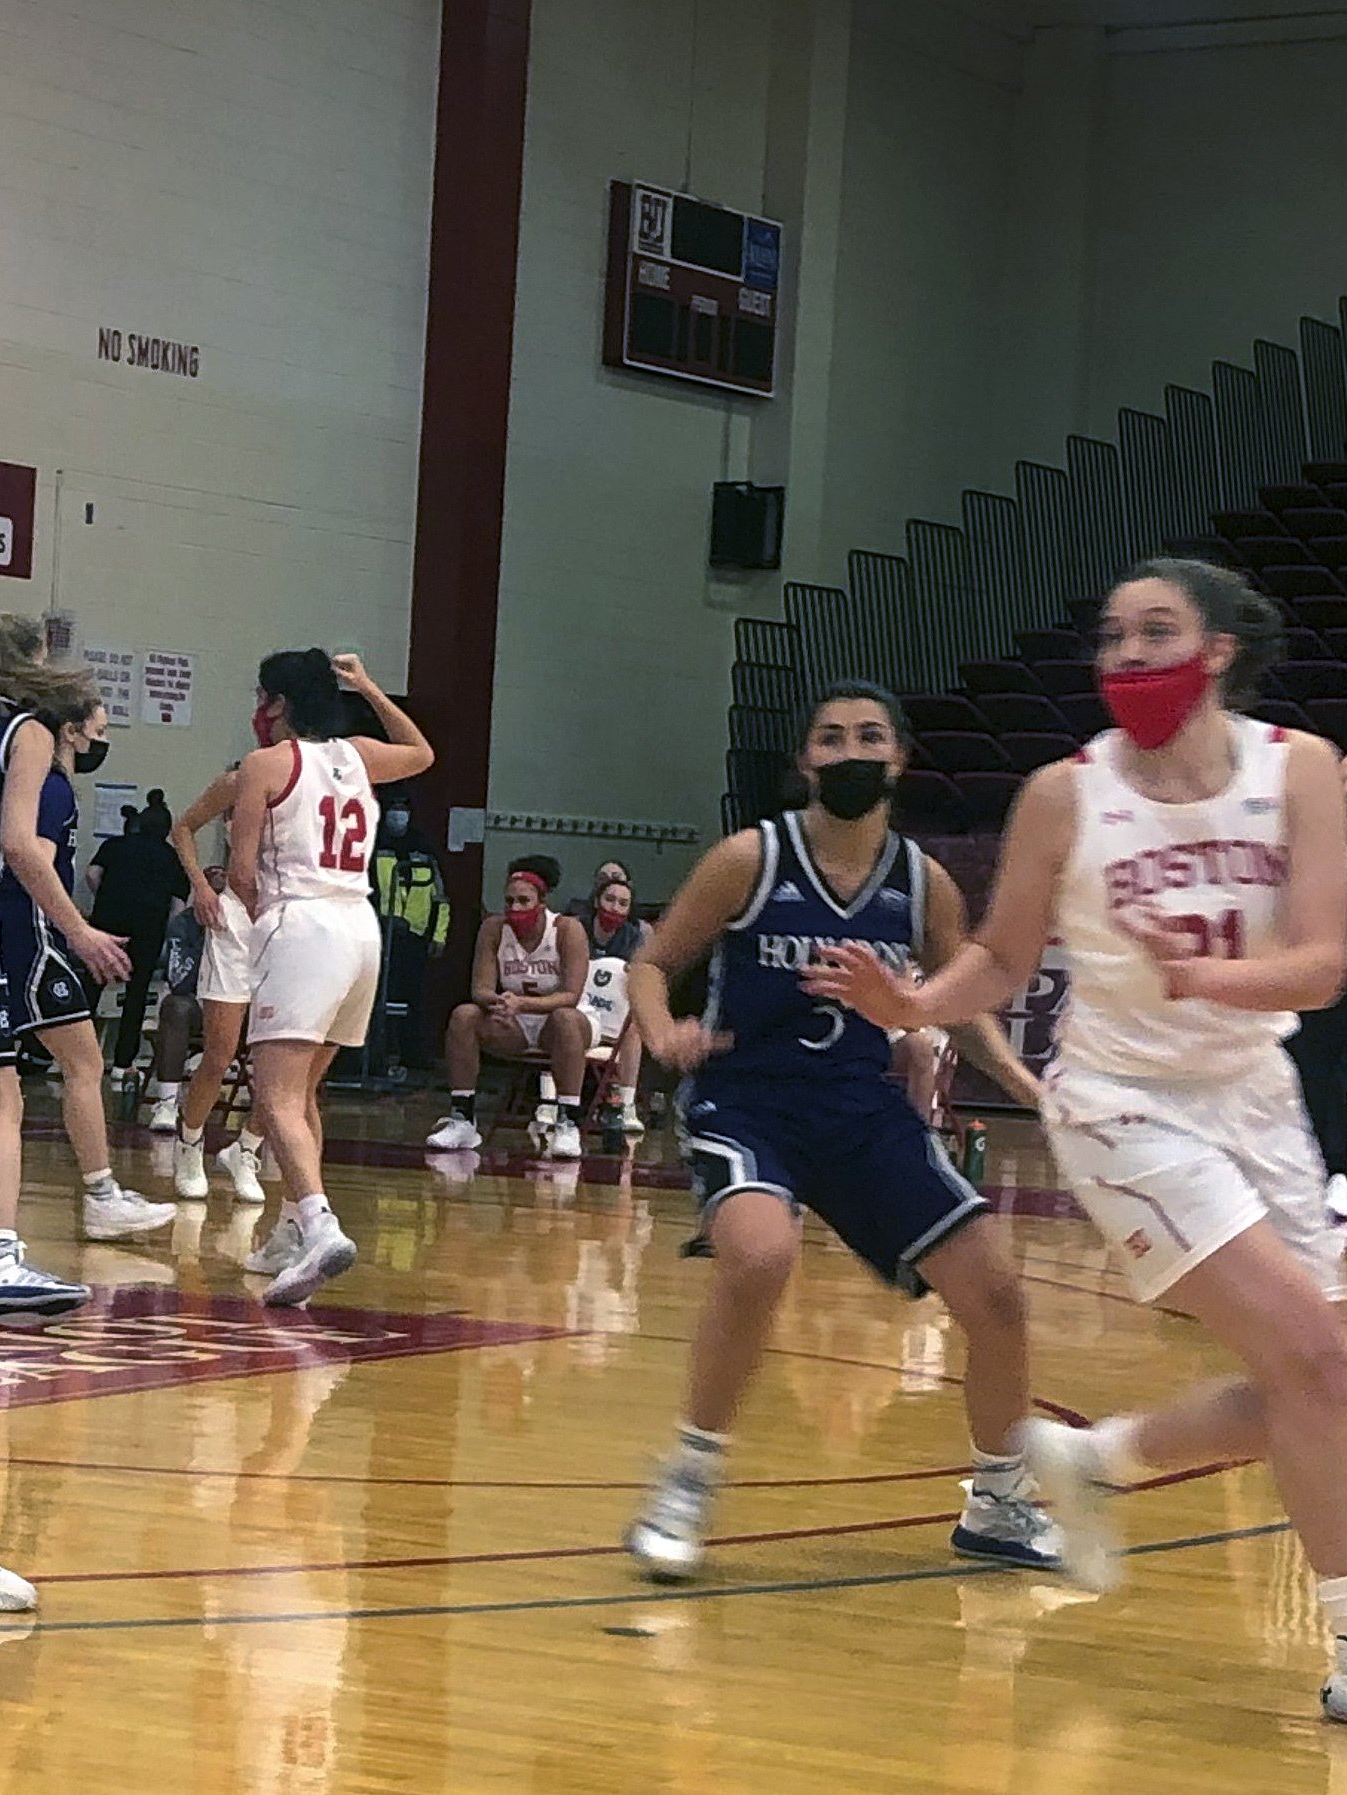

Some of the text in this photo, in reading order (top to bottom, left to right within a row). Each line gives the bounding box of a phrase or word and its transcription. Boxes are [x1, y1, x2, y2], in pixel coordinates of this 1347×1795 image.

[98, 327, 199, 378] NO SMOKING
[319, 796, 367, 872] 12
